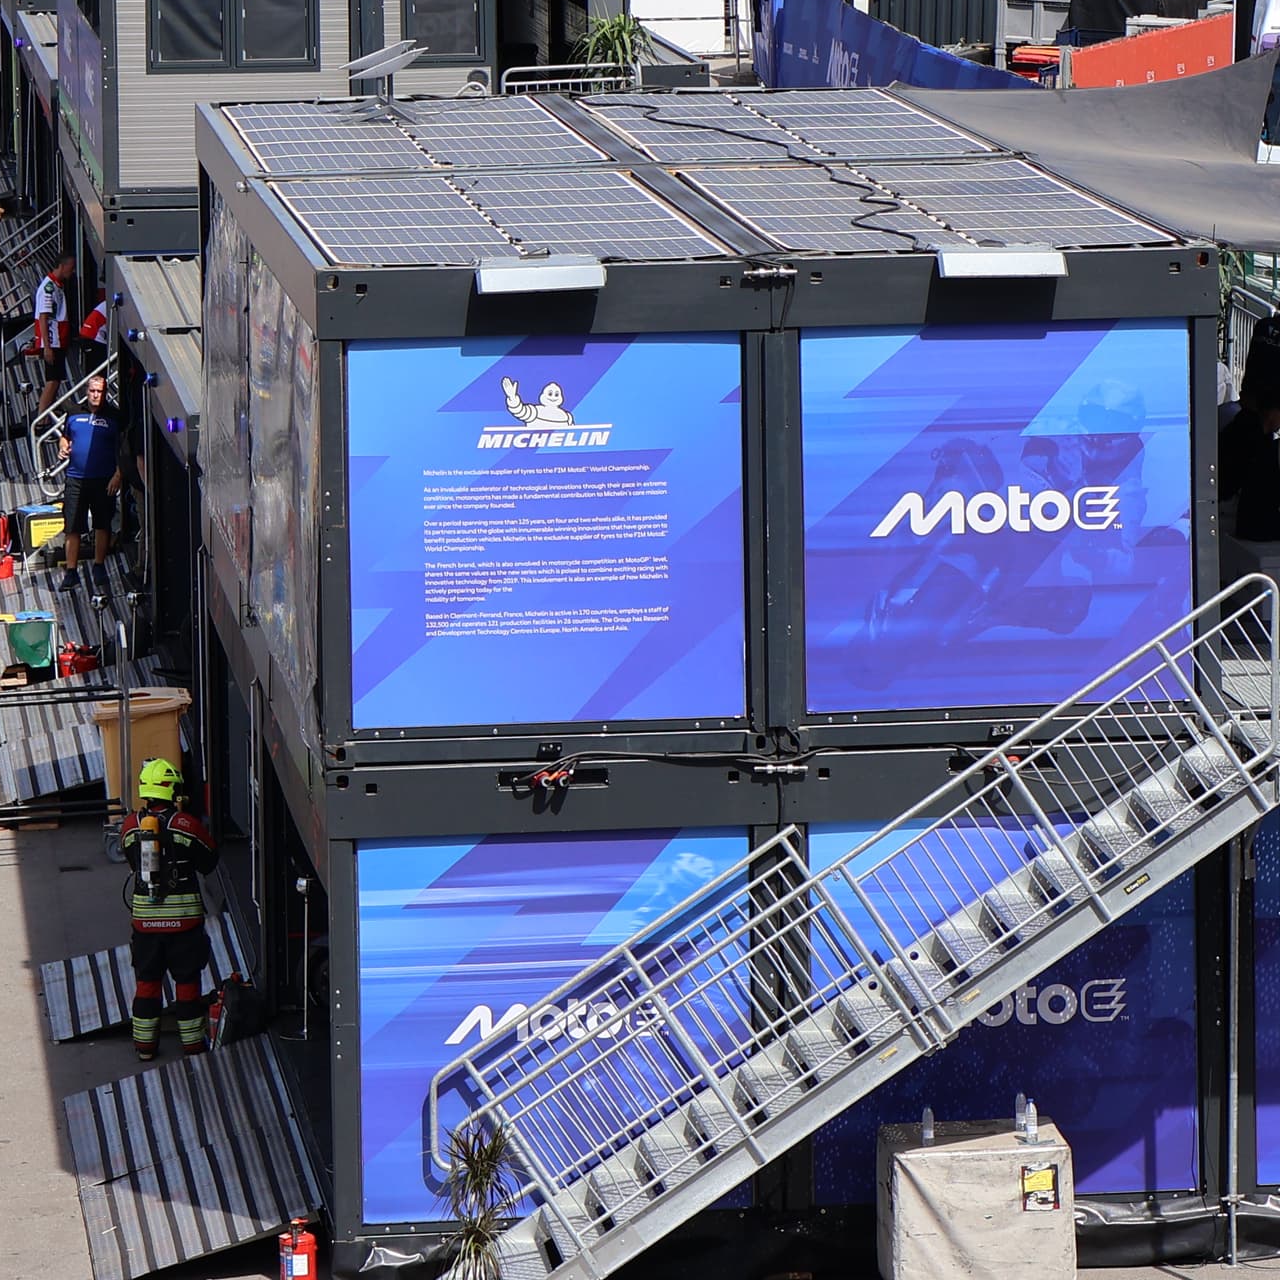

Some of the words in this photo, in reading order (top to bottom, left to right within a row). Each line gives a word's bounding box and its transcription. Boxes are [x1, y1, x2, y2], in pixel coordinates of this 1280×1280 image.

[477, 430, 610, 449] MICHELIN
[869, 485, 1120, 538] MotoE
[965, 978, 1127, 1028] otoE
